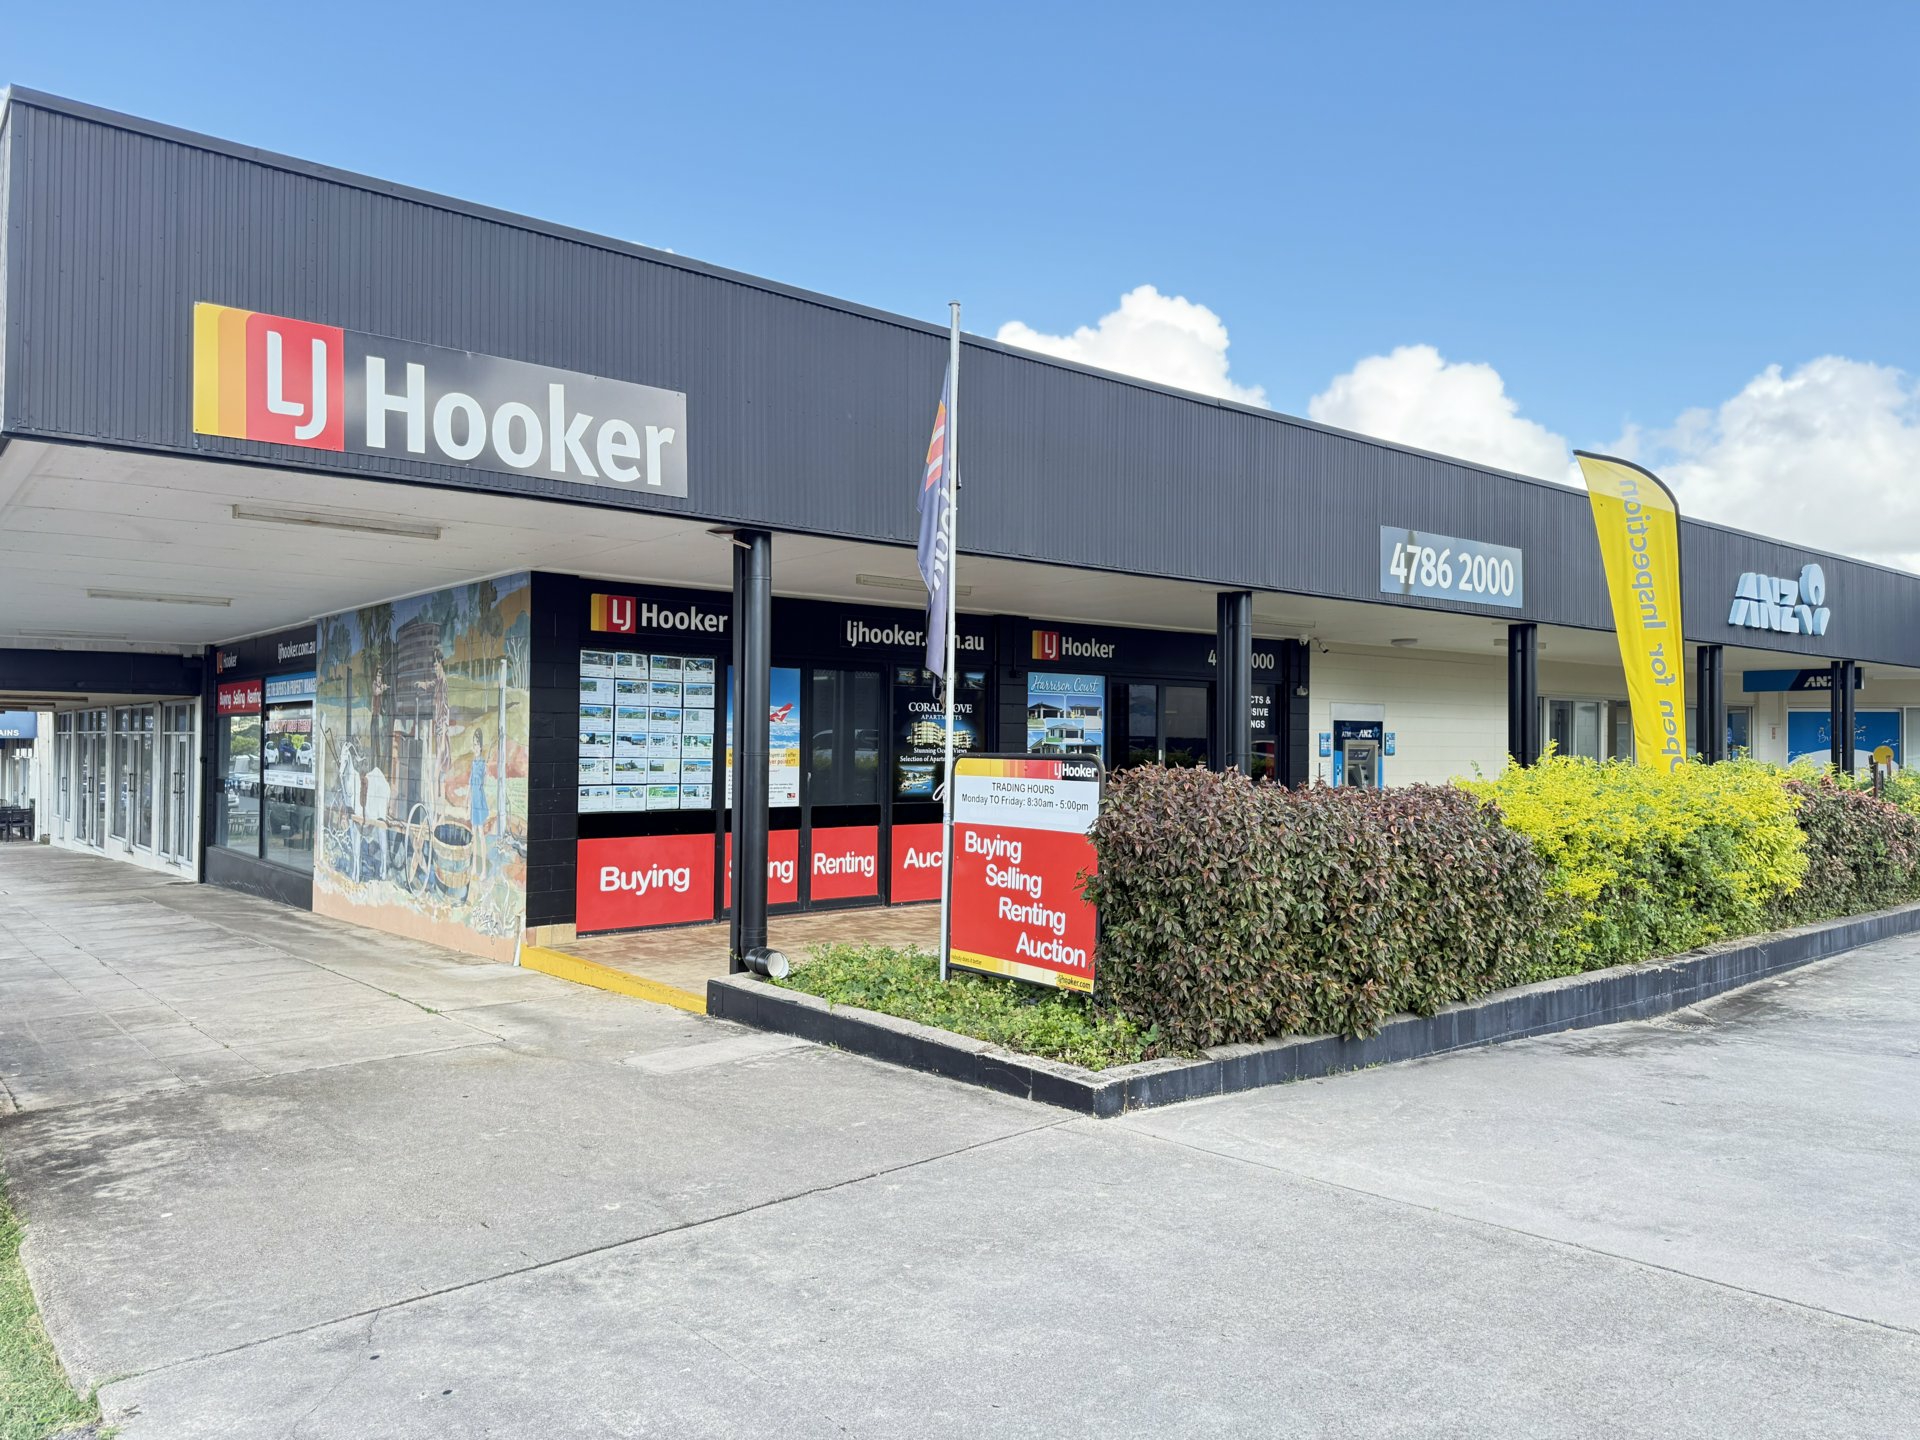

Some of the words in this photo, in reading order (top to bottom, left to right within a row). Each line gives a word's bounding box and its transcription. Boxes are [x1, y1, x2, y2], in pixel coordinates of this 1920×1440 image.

[266, 330, 327, 441] LJ
[366, 355, 675, 486] Hooker
[1390, 543, 1452, 589] 4786
[1458, 552, 1514, 597] 2000
[1728, 572, 1799, 634] ANZ
[612, 599, 631, 631] LJ
[641, 602, 728, 633] Hooker
[847, 620, 984, 651] ljhooker.m.au
[1044, 633, 1056, 659] LJ
[1062, 636, 1115, 659] Hooker
[1251, 653, 1274, 669] 000
[1031, 675, 1071, 692] Harrison
[1073, 677, 1099, 693] Court
[908, 702, 942, 712] CORAL
[952, 703, 973, 713] OVE
[1250, 695, 1264, 704] CTS
[1265, 696, 1271, 704] &
[1251, 707, 1269, 716] SIVE
[1250, 719, 1266, 728] NGS
[1359, 729, 1373, 738] ANZ
[913, 747, 936, 755] Stunning
[1062, 763, 1098, 778] Hooker
[992, 782, 1026, 793] TRADING
[1027, 784, 1055, 795] HOURS
[962, 793, 988, 806] Monday
[989, 795, 999, 804] TO
[1001, 796, 1026, 808] Friday:
[1027, 797, 1054, 808] 8:30am
[1060, 800, 1089, 812] 5:00pm
[904, 847, 944, 869] Auc
[965, 831, 1022, 864] Buying
[813, 851, 875, 877] Renting
[600, 864, 690, 896] Buying
[985, 863, 1042, 899] Selling
[998, 896, 1066, 936] Renting
[1016, 932, 1086, 968] Auction
